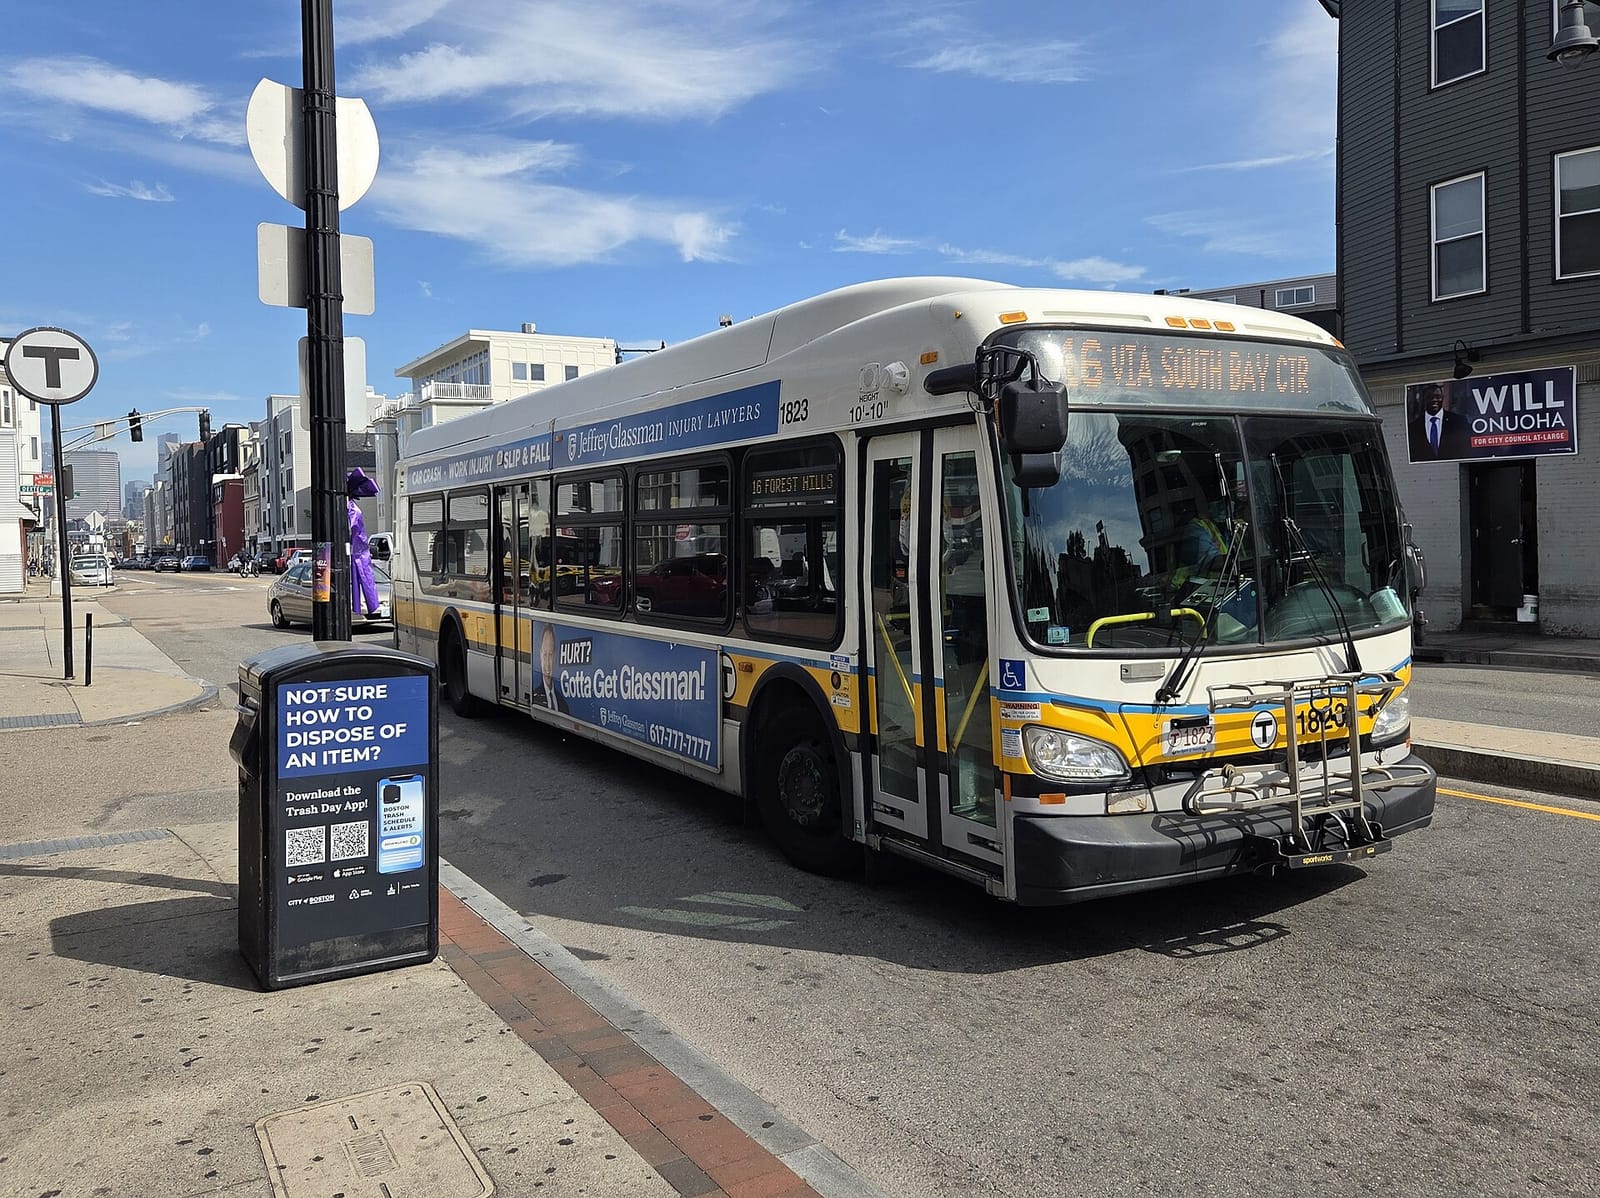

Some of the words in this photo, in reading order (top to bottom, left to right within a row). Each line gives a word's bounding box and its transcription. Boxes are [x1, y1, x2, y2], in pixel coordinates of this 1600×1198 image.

[23, 345, 80, 388] T
[1063, 338, 1103, 388] 16
[1112, 344, 1152, 387] VIA
[1161, 346, 1223, 390] SOUTH
[1229, 351, 1269, 392] BAY
[1276, 354, 1310, 394] CTR
[859, 392, 879, 403] HEIGHT
[1472, 381, 1565, 414] WILL
[668, 414, 704, 438] INJURY
[707, 403, 761, 430] LAWYERS
[780, 398, 809, 425] 1823
[1472, 412, 1565, 433] ONUOHA
[1488, 436, 1503, 444] CITY
[1505, 433, 1531, 443] COUNCIL
[1533, 432, 1565, 441] AT-LARGE
[412, 471, 423, 485] CAR
[423, 466, 442, 483] CRASH
[449, 461, 467, 479] WORK
[469, 455, 494, 476] INJURY
[504, 448, 520, 469] SLIP
[522, 447, 529, 466] &
[530, 442, 550, 464] FALL
[752, 480, 762, 494] 16
[765, 476, 799, 494] FOREST
[802, 473, 833, 491] HILLS
[560, 640, 592, 664] HURT?
[560, 670, 592, 698] Gotta
[593, 668, 618, 699] Get
[620, 660, 706, 700] Glassman!
[286, 688, 331, 705] NOT
[335, 684, 388, 702] SURE
[286, 708, 340, 726] HOW
[345, 706, 373, 721] TO
[622, 714, 645, 733] Glassman
[286, 726, 375, 748] DISPOSE
[379, 723, 407, 739] OF
[650, 723, 711, 761] 617-777-7777
[1184, 726, 1214, 746] 1823
[1255, 720, 1273, 743] T
[285, 751, 316, 769] AN
[322, 746, 381, 766] ITEM?
[286, 787, 341, 802] Download
[343, 785, 362, 795] the
[286, 803, 319, 817] Trash
[321, 803, 343, 814] Day
[344, 799, 369, 812] App!
[384, 817, 416, 825] SCHEDULE
[1302, 854, 1333, 865] sportworks
[309, 894, 335, 904] BOSTON
